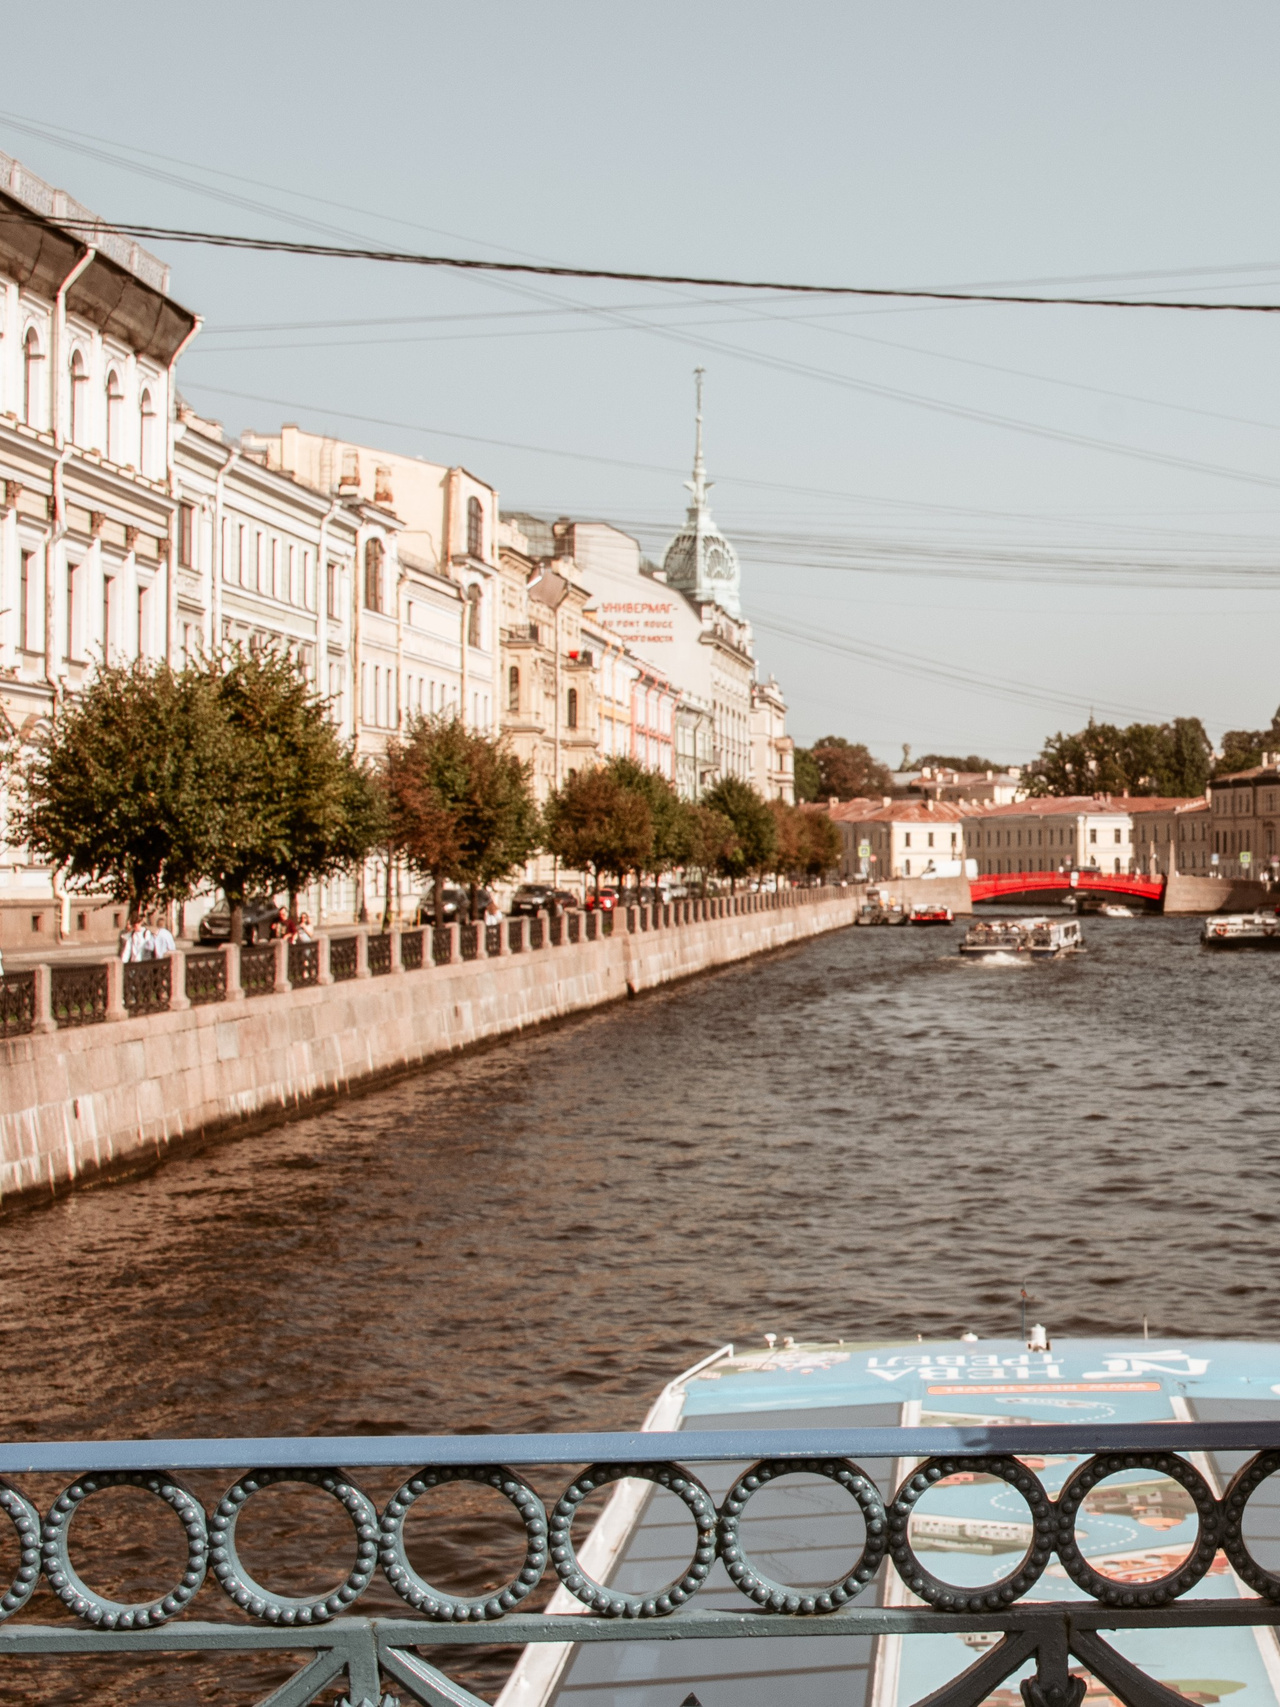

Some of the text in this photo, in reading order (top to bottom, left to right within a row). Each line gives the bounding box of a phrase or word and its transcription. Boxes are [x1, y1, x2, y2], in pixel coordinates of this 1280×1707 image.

[617, 620, 640, 628] PONT
[867, 1354, 1064, 1369] ТРЕВЕЛ
[866, 1364, 1064, 1380] НЕВА
